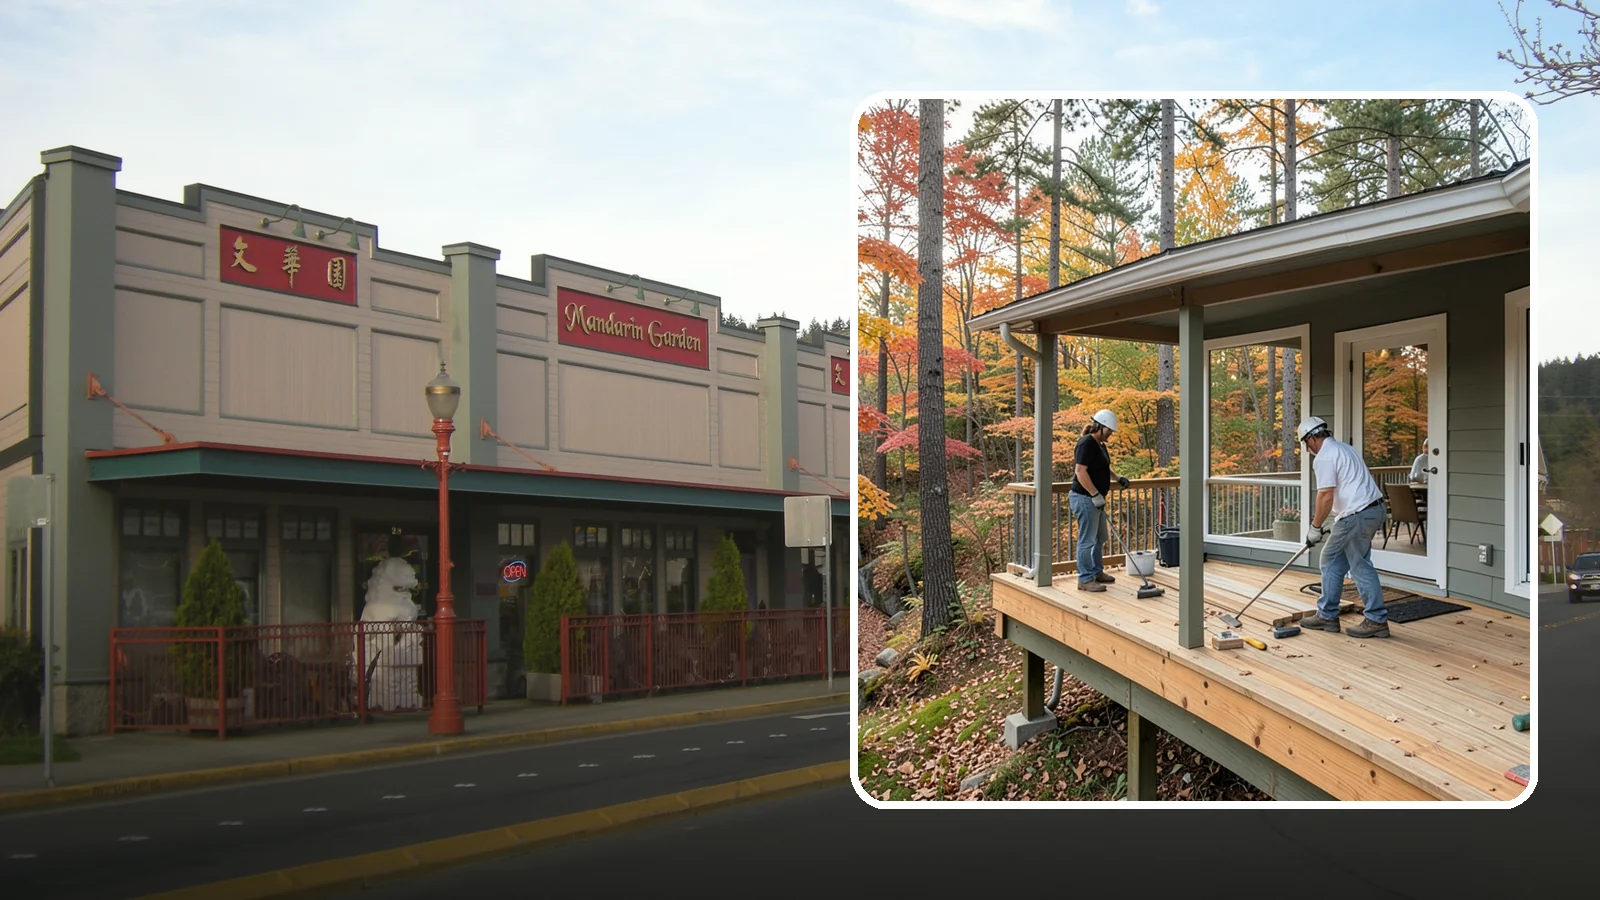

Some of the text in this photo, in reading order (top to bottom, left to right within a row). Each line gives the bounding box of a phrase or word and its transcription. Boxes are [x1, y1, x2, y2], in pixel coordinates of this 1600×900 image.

[565, 302, 701, 352] Mandarin Garden
[503, 565, 527, 578] OPEN
